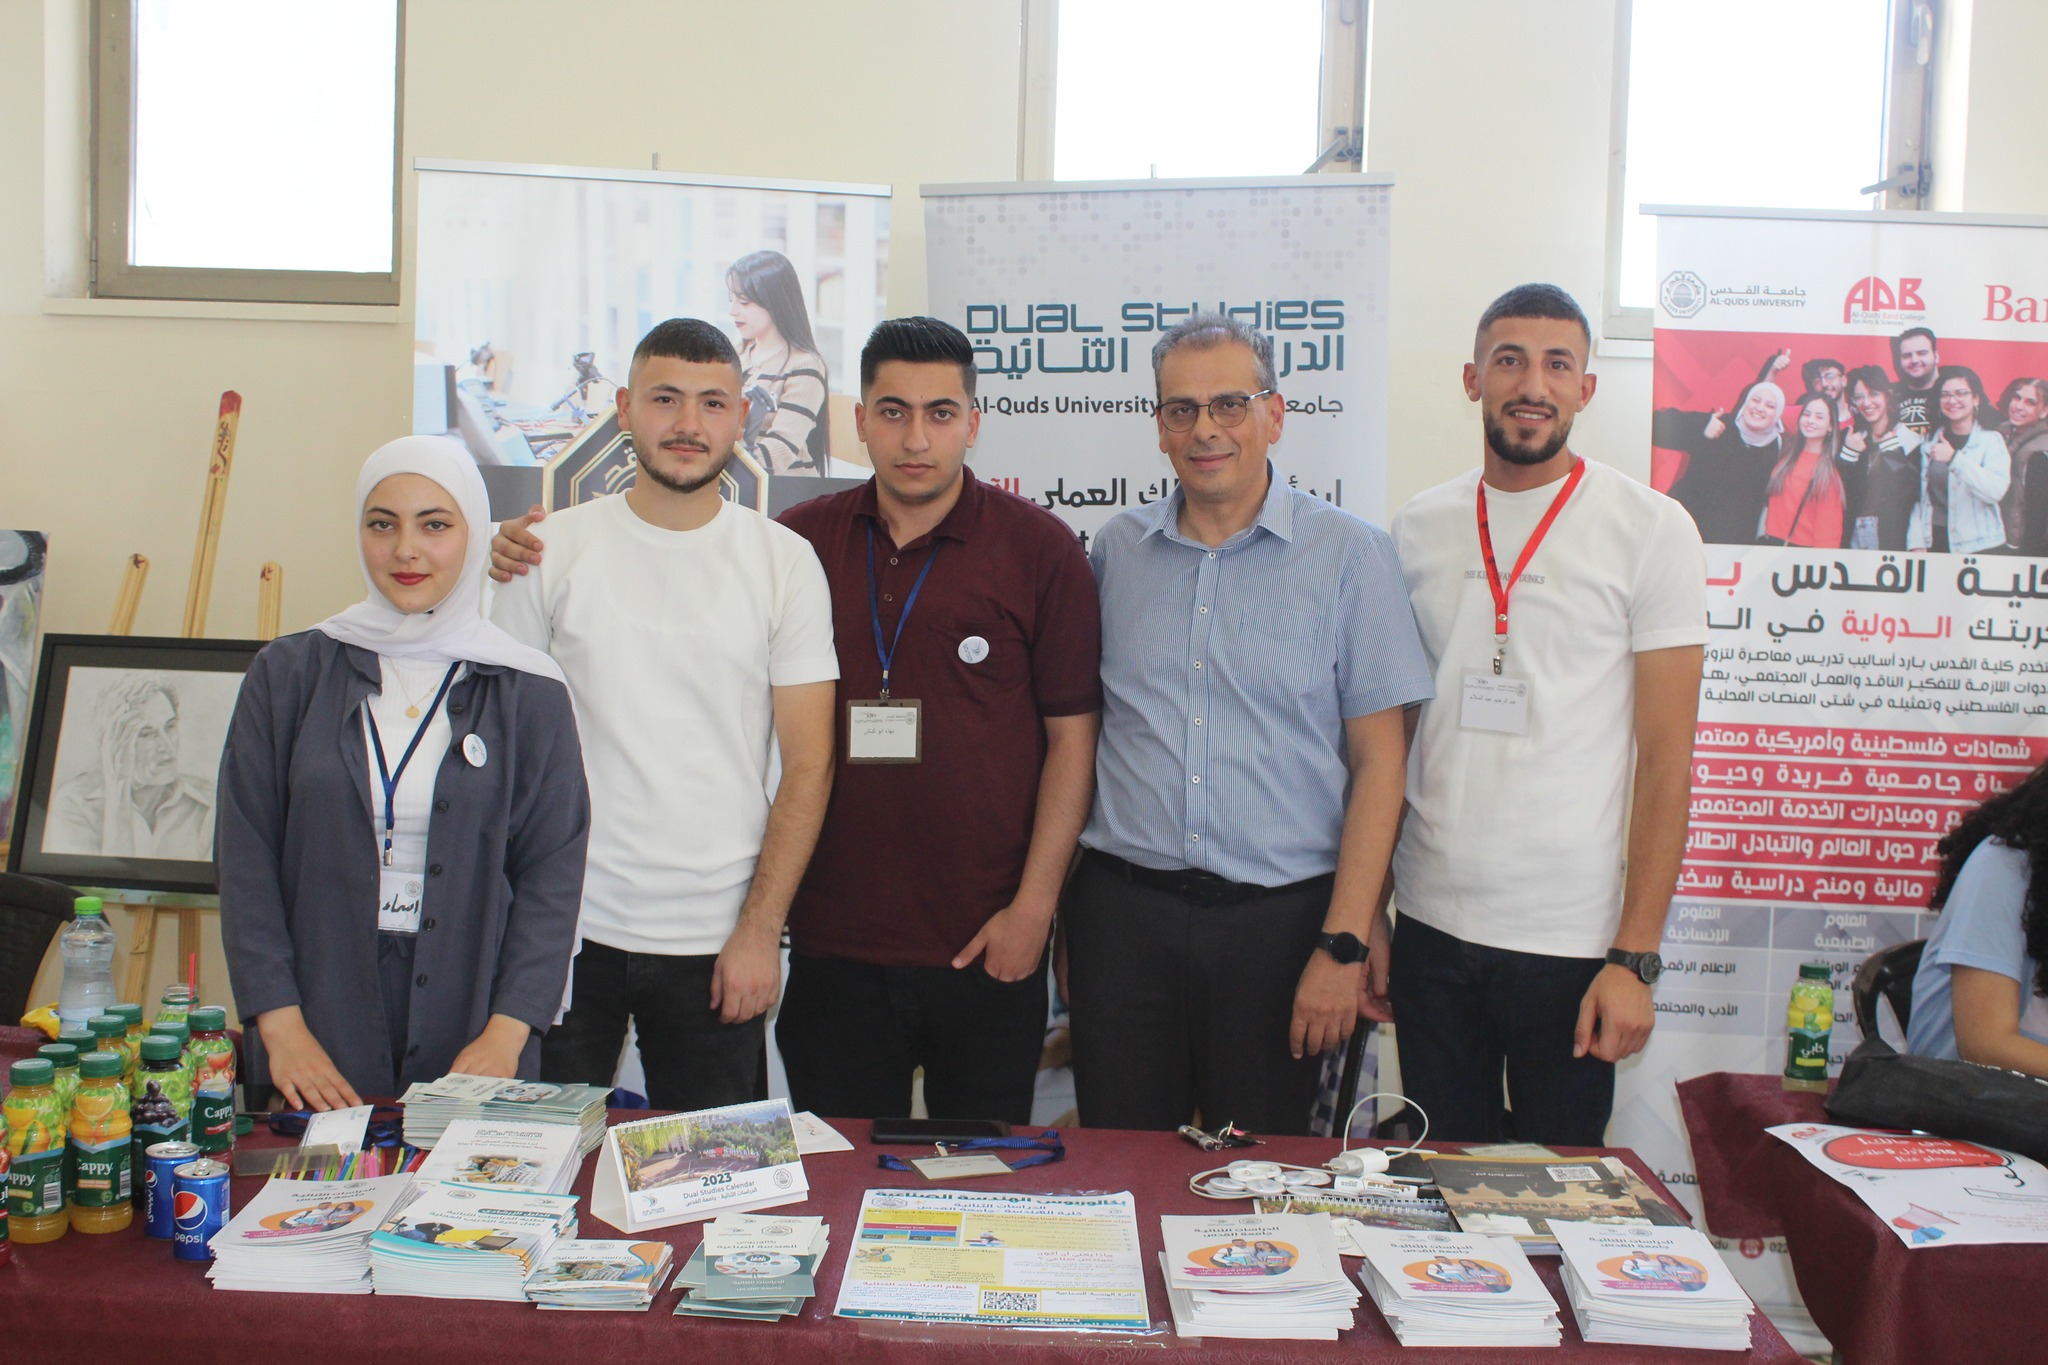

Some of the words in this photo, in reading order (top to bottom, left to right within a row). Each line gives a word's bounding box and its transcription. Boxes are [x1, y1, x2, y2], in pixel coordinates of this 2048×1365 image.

[1709, 284, 1760, 296] القدس
[1762, 285, 1807, 296] جامعة
[1709, 297, 1751, 306] AL-QUDS
[1752, 297, 1806, 307] UNIVERSITY
[972, 337, 1128, 380] الثنائية
[972, 396, 1050, 416] Al-Quds
[1055, 396, 1157, 418] University
[1286, 396, 1344, 418] جامع
[1772, 555, 1926, 597] القدس
[1767, 609, 1825, 643] في
[1842, 610, 1951, 643] الدولية
[1968, 618, 2048, 649] ربتك
[1703, 648, 1735, 662] لتزوي
[1738, 648, 1792, 665] معاصرة
[1796, 652, 1845, 668] تدريس
[1849, 653, 1895, 669] أساليب
[1899, 655, 1926, 670] بارد
[1930, 656, 1977, 671] القدس
[1981, 659, 2014, 675] كلية
[1811, 672, 1861, 689] والعمل
[1865, 674, 1904, 689] الناقد
[1907, 676, 1961, 692] للتفكير
[1965, 679, 2010, 694] اللازمة
[2014, 681, 2048, 696] دوات
[1705, 687, 1755, 704] المحلية
[1758, 691, 1816, 705] المنصات
[1820, 693, 1855, 708] شتى
[1859, 695, 1883, 712] في
[1888, 697, 1941, 713] وتمثيله
[1946, 700, 2019, 717] الفلسطيني
[1694, 728, 1749, 747] معتم
[1755, 728, 1845, 756] وأمريكية
[1851, 733, 1947, 758] فلسطينية
[1953, 739, 2031, 759] شهادات
[1691, 764, 1764, 787] وحيو
[1776, 764, 1853, 789] فريدة
[1865, 768, 1961, 795] جامعية
[1689, 797, 1774, 820] المجتمعي
[1780, 798, 1845, 820] الخدمة
[1851, 804, 1938, 829] ومبادرات
[1685, 830, 1737, 852] الطلاب
[1742, 833, 1814, 859] والتبادل
[1819, 837, 1871, 860] العالم
[1876, 840, 1915, 863] حول
[1675, 868, 1723, 891] سخي
[1731, 870, 1805, 897] دراسية
[1813, 875, 1866, 901] ومنح
[1874, 877, 1923, 901] مالية
[1678, 906, 1721, 921] العلوم
[1824, 913, 1867, 928] العلوم
[1667, 924, 1729, 943] الإنسانية
[1814, 933, 1875, 952] الطبيعية
[1661, 959, 1698, 975] الرقم
[1700, 960, 1736, 975] الإعلام
[1653, 1001, 1705, 1017] والمجتم
[1709, 1003, 1738, 1016] الأدب
[1801, 1042, 1825, 1059] كابي
[701, 1172, 732, 1187] 2023
[683, 1191, 699, 1199] Dual
[700, 1187, 725, 1197] Studies
[725, 1180, 755, 1191] Calendar
[720, 1191, 737, 1199] الثنائية
[737, 1187, 758, 1197] الدراسات
[685, 1198, 701, 1207] القدس
[701, 1196, 717, 1204] جامعة
[175, 1231, 204, 1246] pepsi
